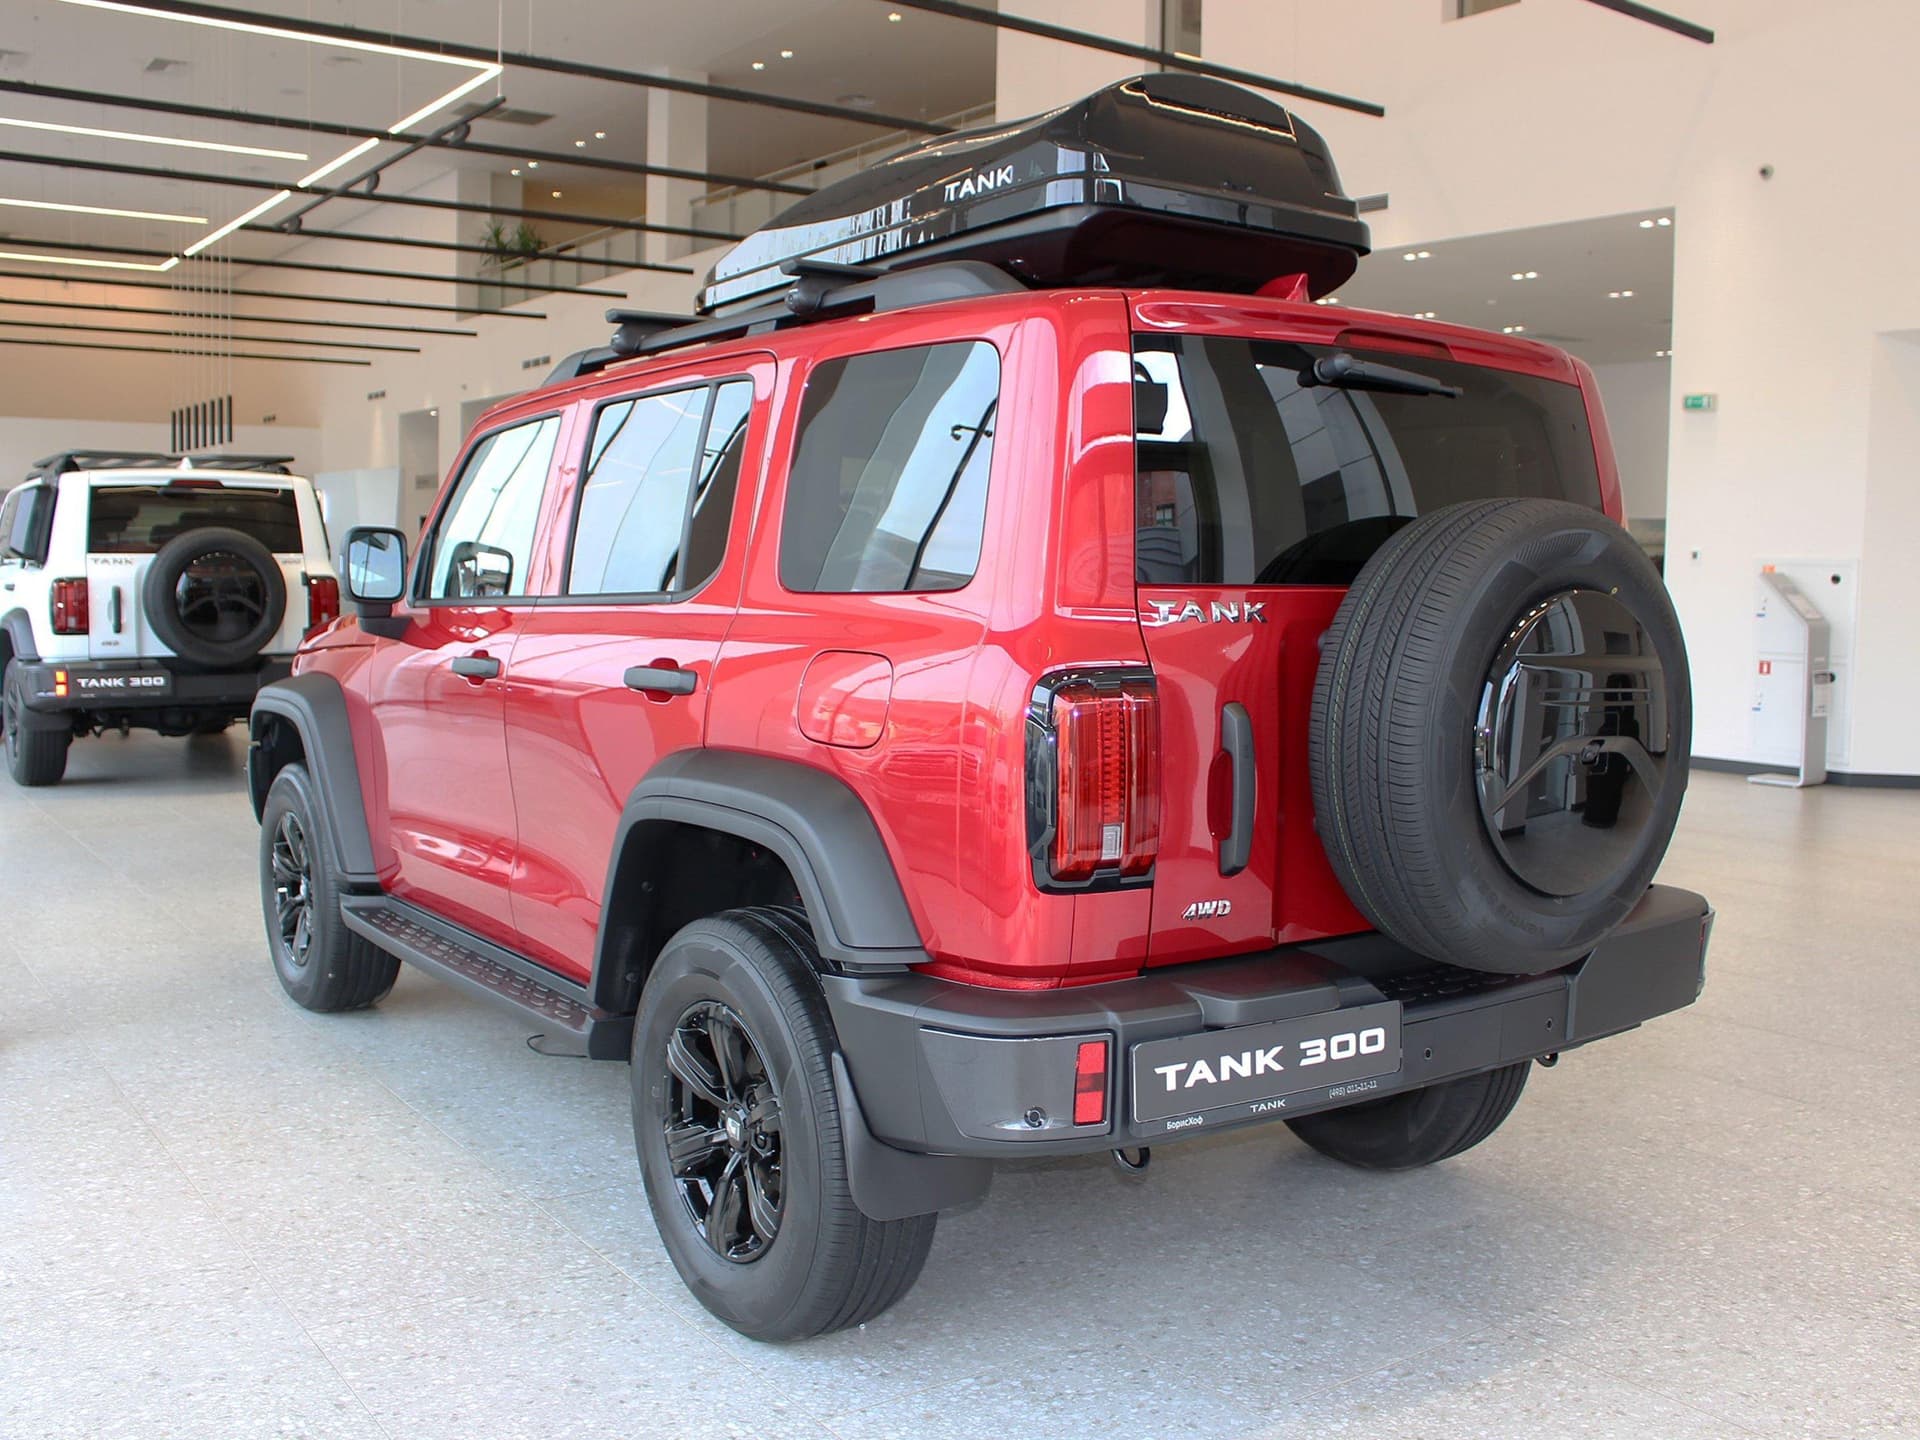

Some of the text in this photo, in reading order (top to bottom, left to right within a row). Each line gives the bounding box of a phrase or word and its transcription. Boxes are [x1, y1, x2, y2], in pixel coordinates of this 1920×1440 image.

[943, 164, 1014, 202] TANK
[1147, 599, 1268, 623] TANK
[76, 676, 165, 689] TANK 300
[1181, 899, 1232, 921] AWD
[1153, 1027, 1386, 1092] TANK 300
[1249, 1098, 1287, 1113] TANK
